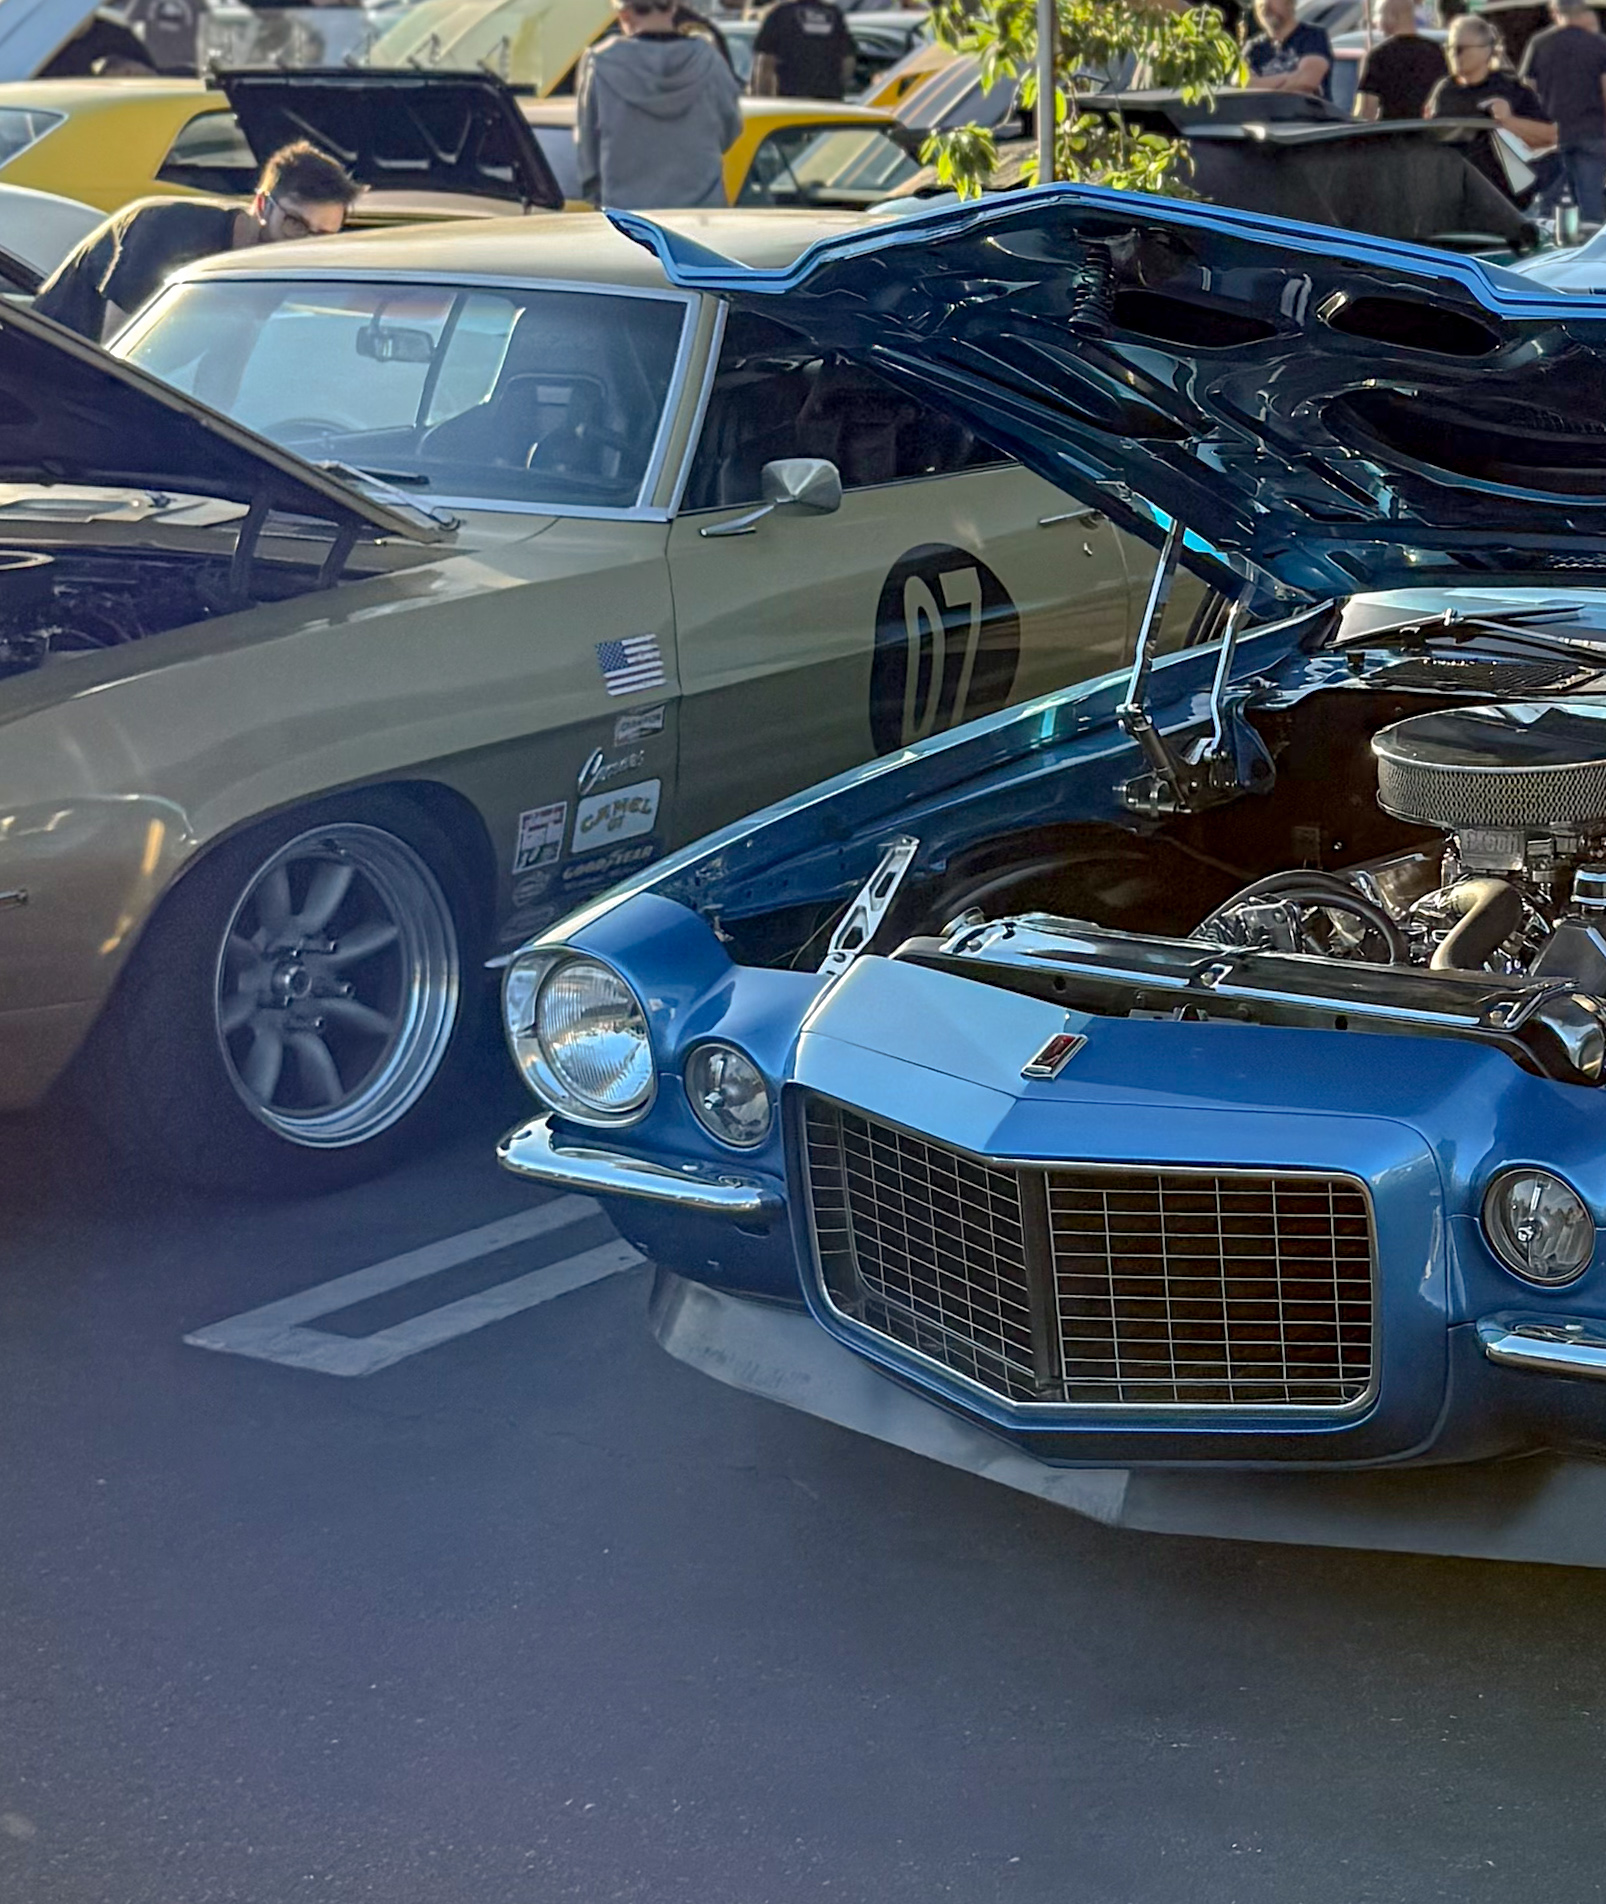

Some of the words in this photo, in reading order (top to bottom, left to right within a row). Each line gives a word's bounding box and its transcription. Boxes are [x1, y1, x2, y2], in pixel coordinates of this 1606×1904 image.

[901, 566, 983, 750] 07
[581, 796, 652, 834] CAMEL
[562, 845, 654, 880] GOODYEAR
